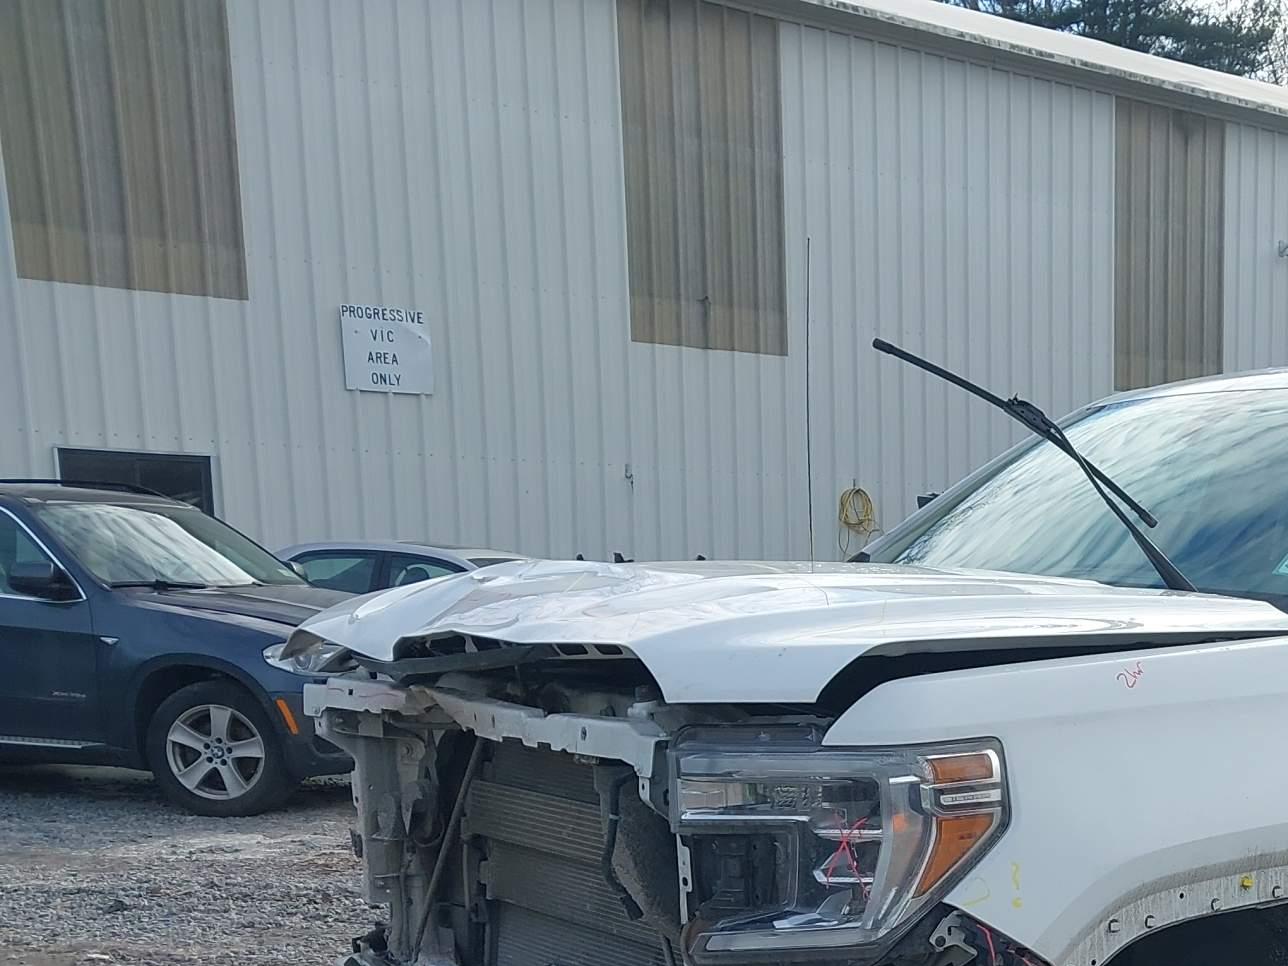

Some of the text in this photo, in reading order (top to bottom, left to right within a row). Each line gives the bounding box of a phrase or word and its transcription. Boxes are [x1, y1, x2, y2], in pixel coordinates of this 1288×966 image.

[341, 304, 424, 324] PROGRESSIVE
[370, 329, 394, 342] VIC
[367, 351, 399, 366] AREA
[371, 372, 401, 387] ONLY
